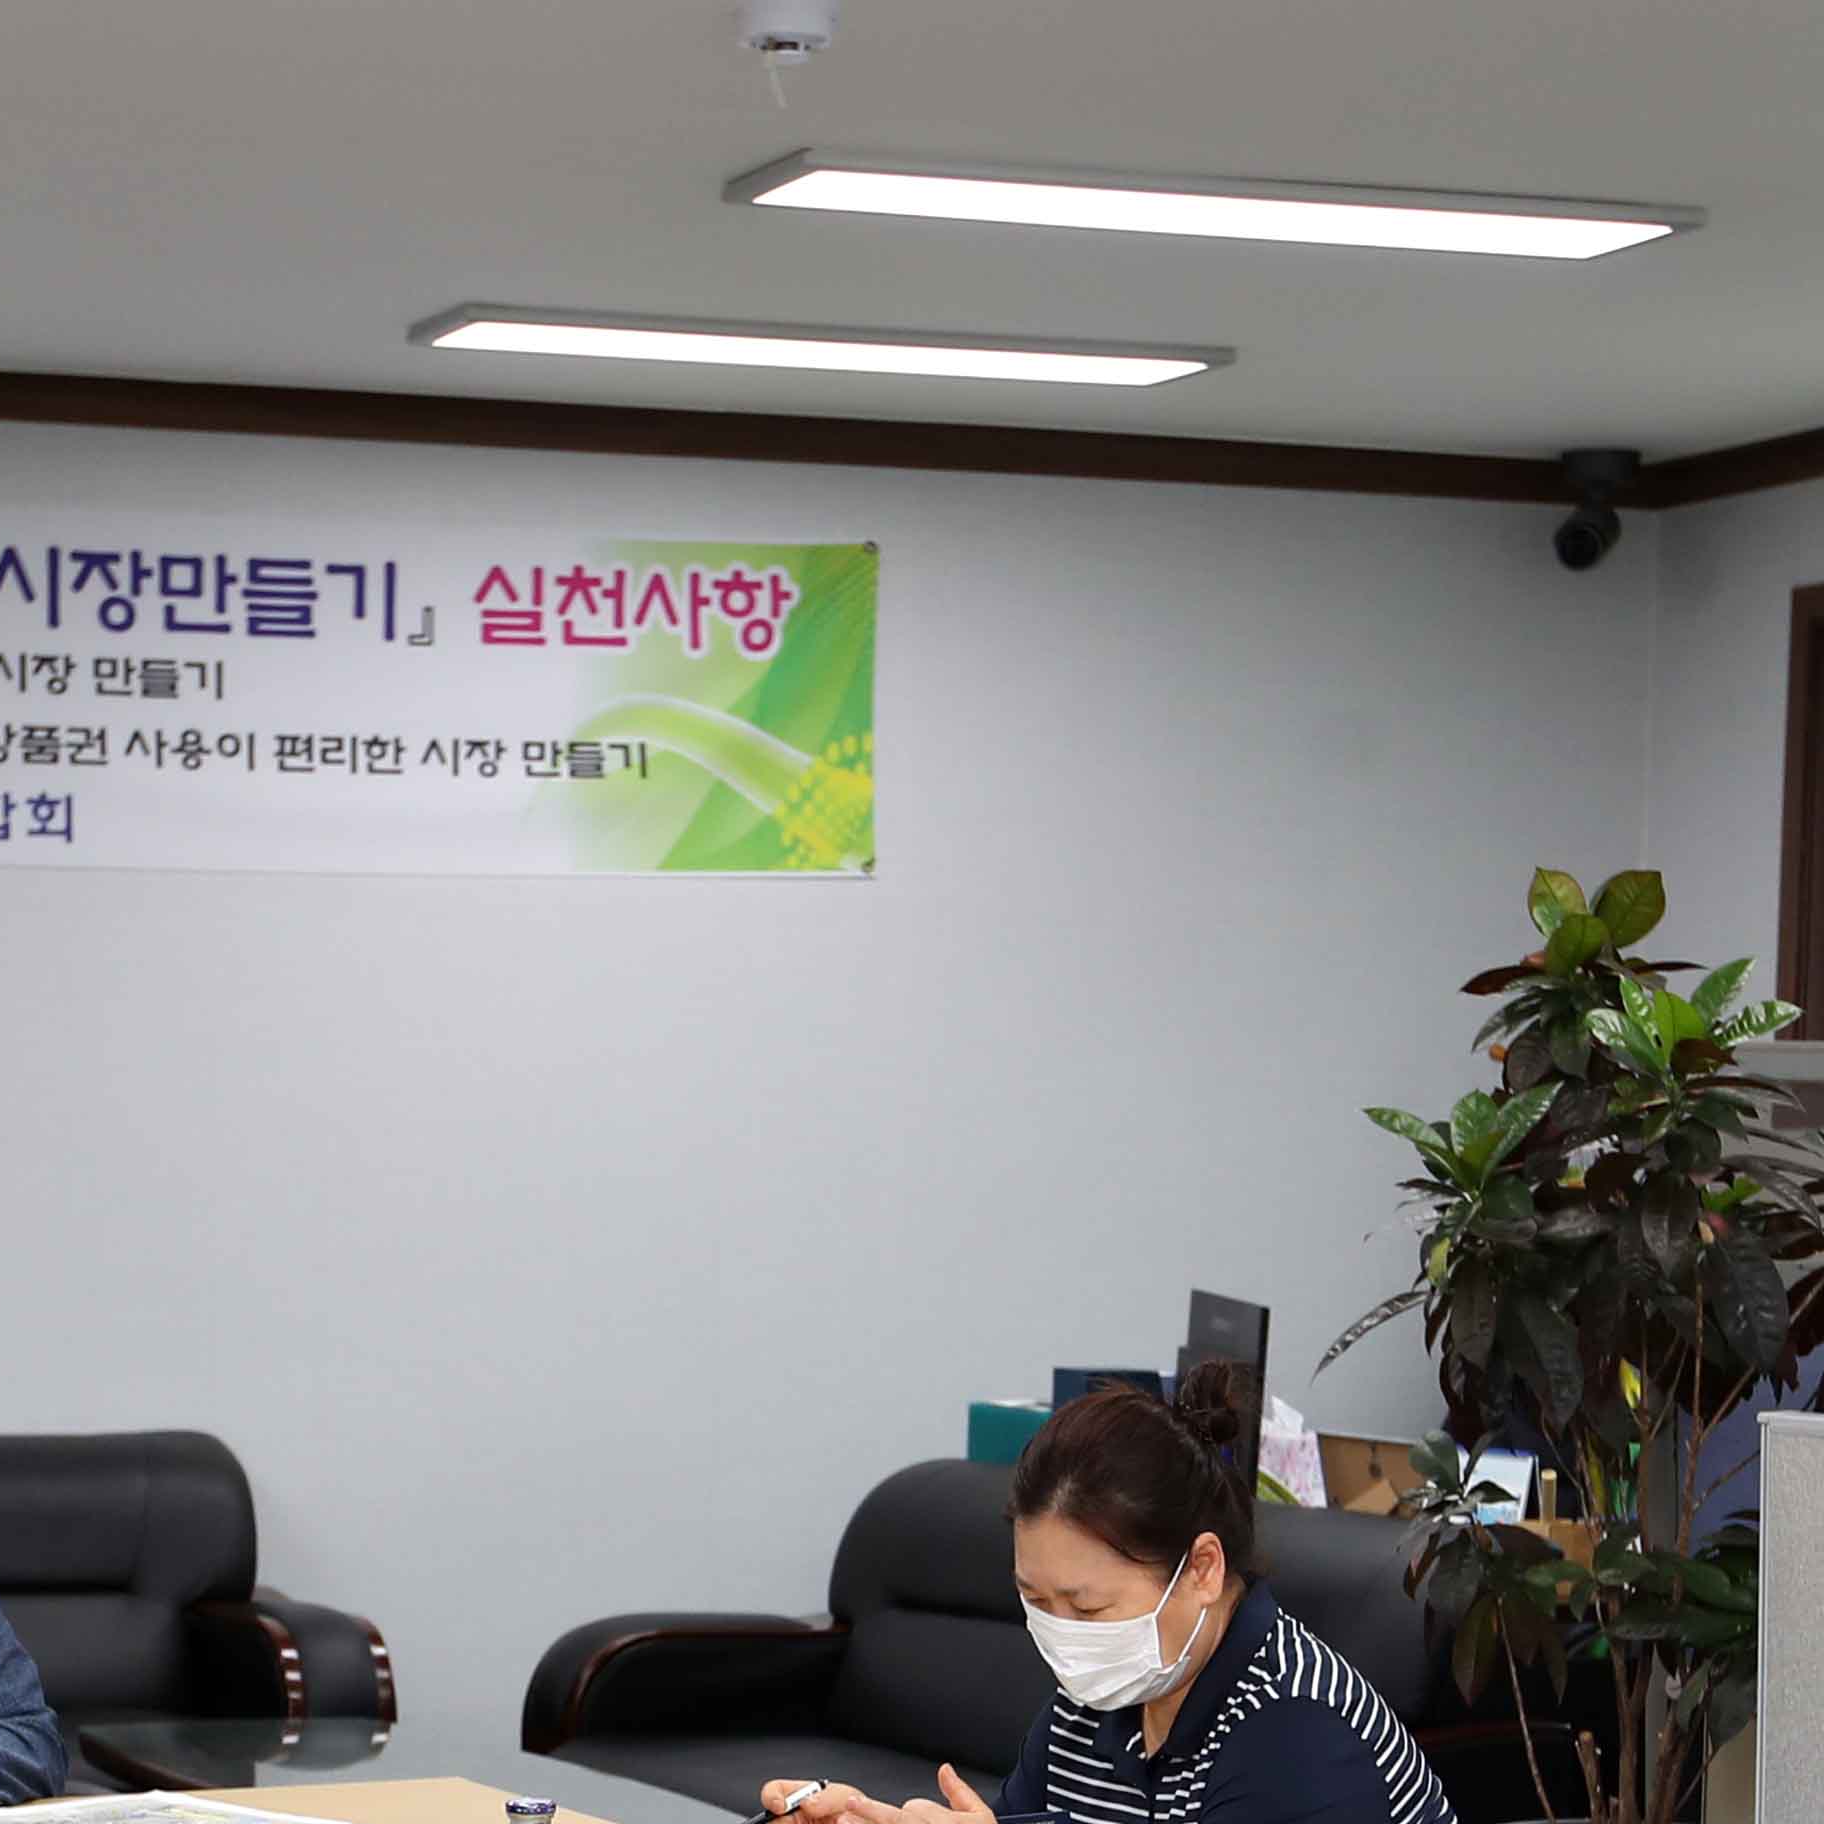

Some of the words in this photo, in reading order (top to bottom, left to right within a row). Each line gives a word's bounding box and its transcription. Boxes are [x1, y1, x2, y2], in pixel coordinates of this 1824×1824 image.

[474, 564, 794, 653] 실천사항
[93, 657, 223, 700] 만들기
[124, 728, 255, 771] 사용이
[274, 734, 406, 775] 편리한
[421, 738, 507, 778] 시장
[521, 739, 649, 780] 만들기
